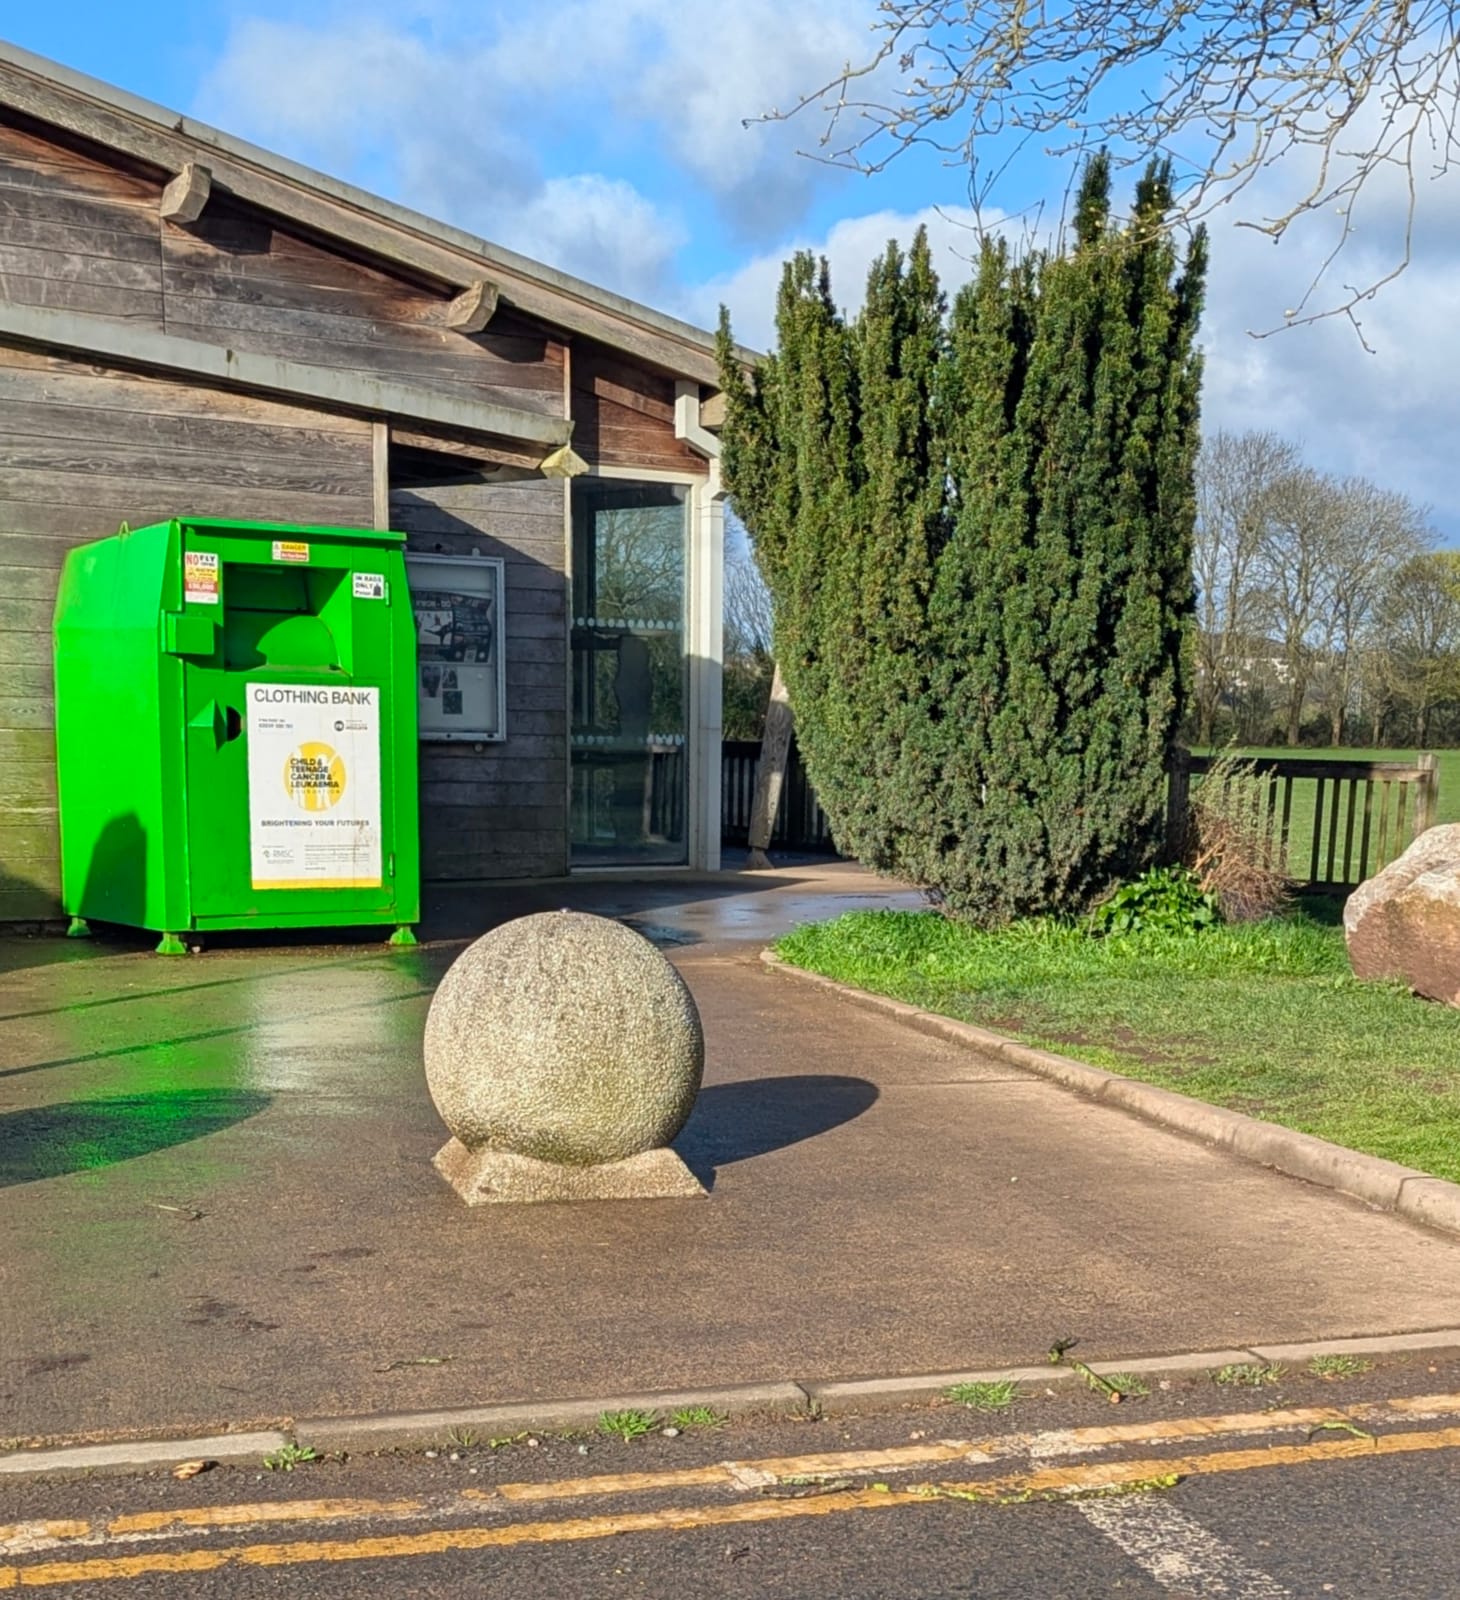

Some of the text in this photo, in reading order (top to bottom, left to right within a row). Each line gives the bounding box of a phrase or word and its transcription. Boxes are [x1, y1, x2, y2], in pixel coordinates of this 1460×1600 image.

[186, 554, 199, 566] NO
[254, 688, 371, 705] CLOTHING BANK
[290, 758, 323, 766] CHILD &
[290, 773, 326, 781] CANCER
[261, 819, 312, 827] BRIGHTENING
